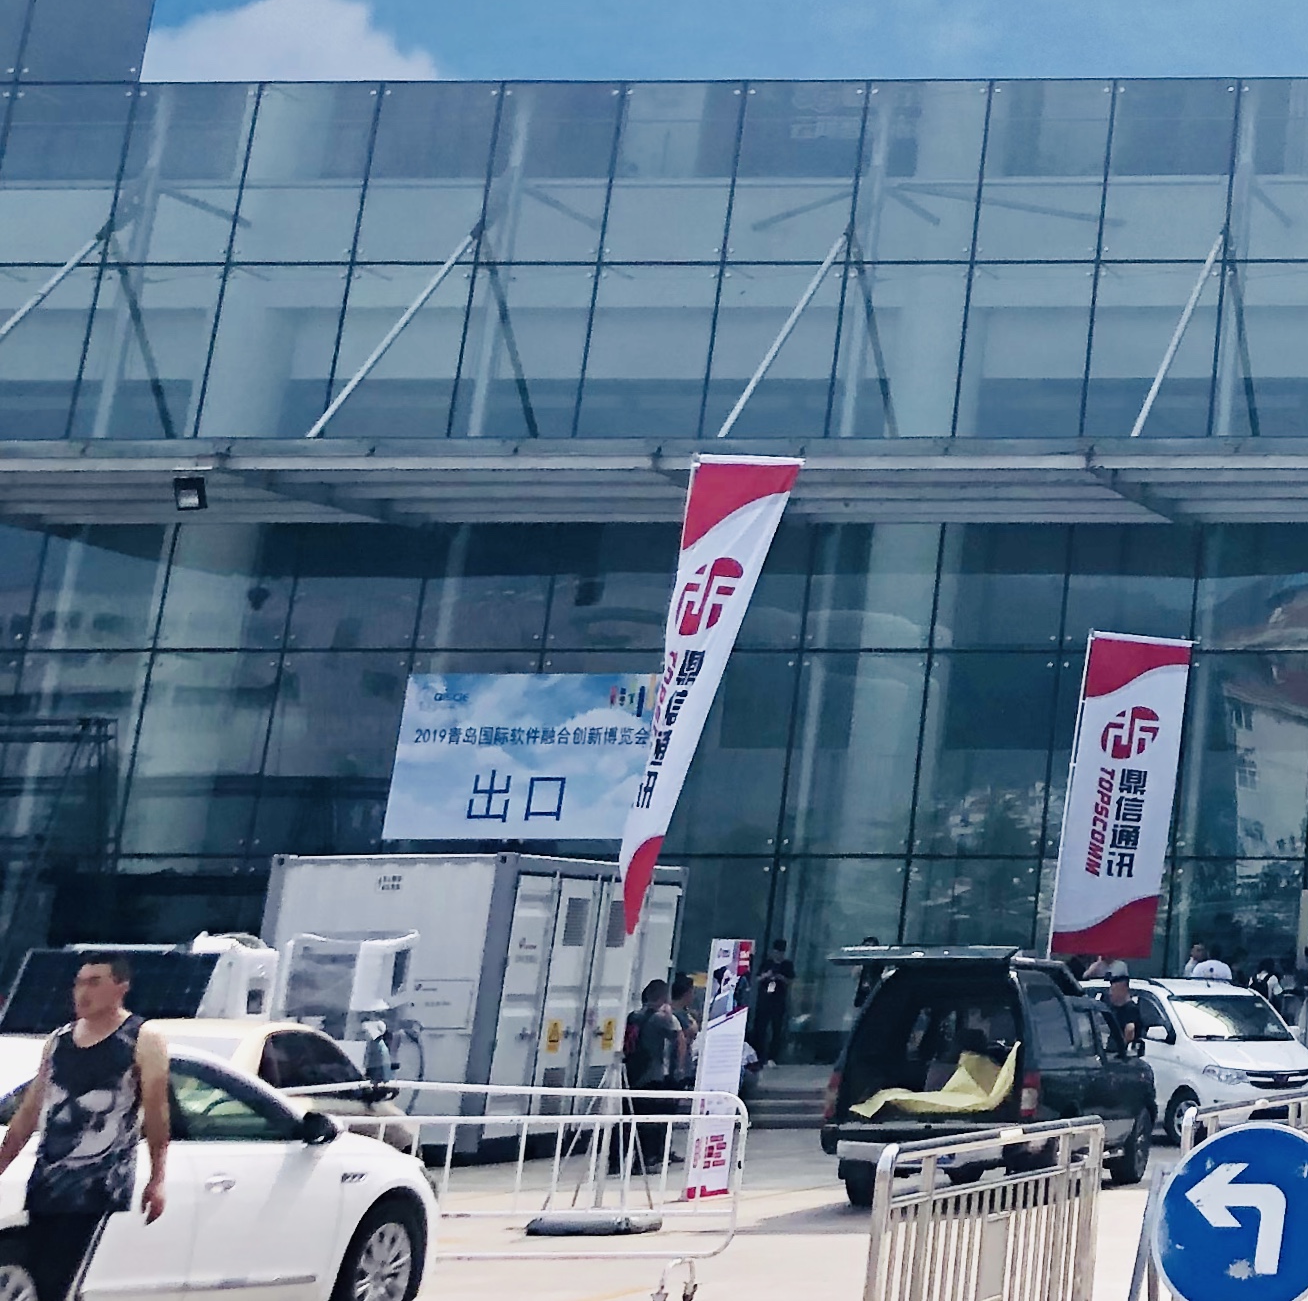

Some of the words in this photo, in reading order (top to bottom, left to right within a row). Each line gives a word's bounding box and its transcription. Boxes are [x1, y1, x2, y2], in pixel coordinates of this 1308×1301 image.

[414, 726, 652, 746] 2019青岛国际软件融合创新博览会
[466, 769, 567, 823] 出口
[1084, 766, 1115, 878] TOPSCOMM
[1105, 767, 1149, 878] 鼎信通讯
